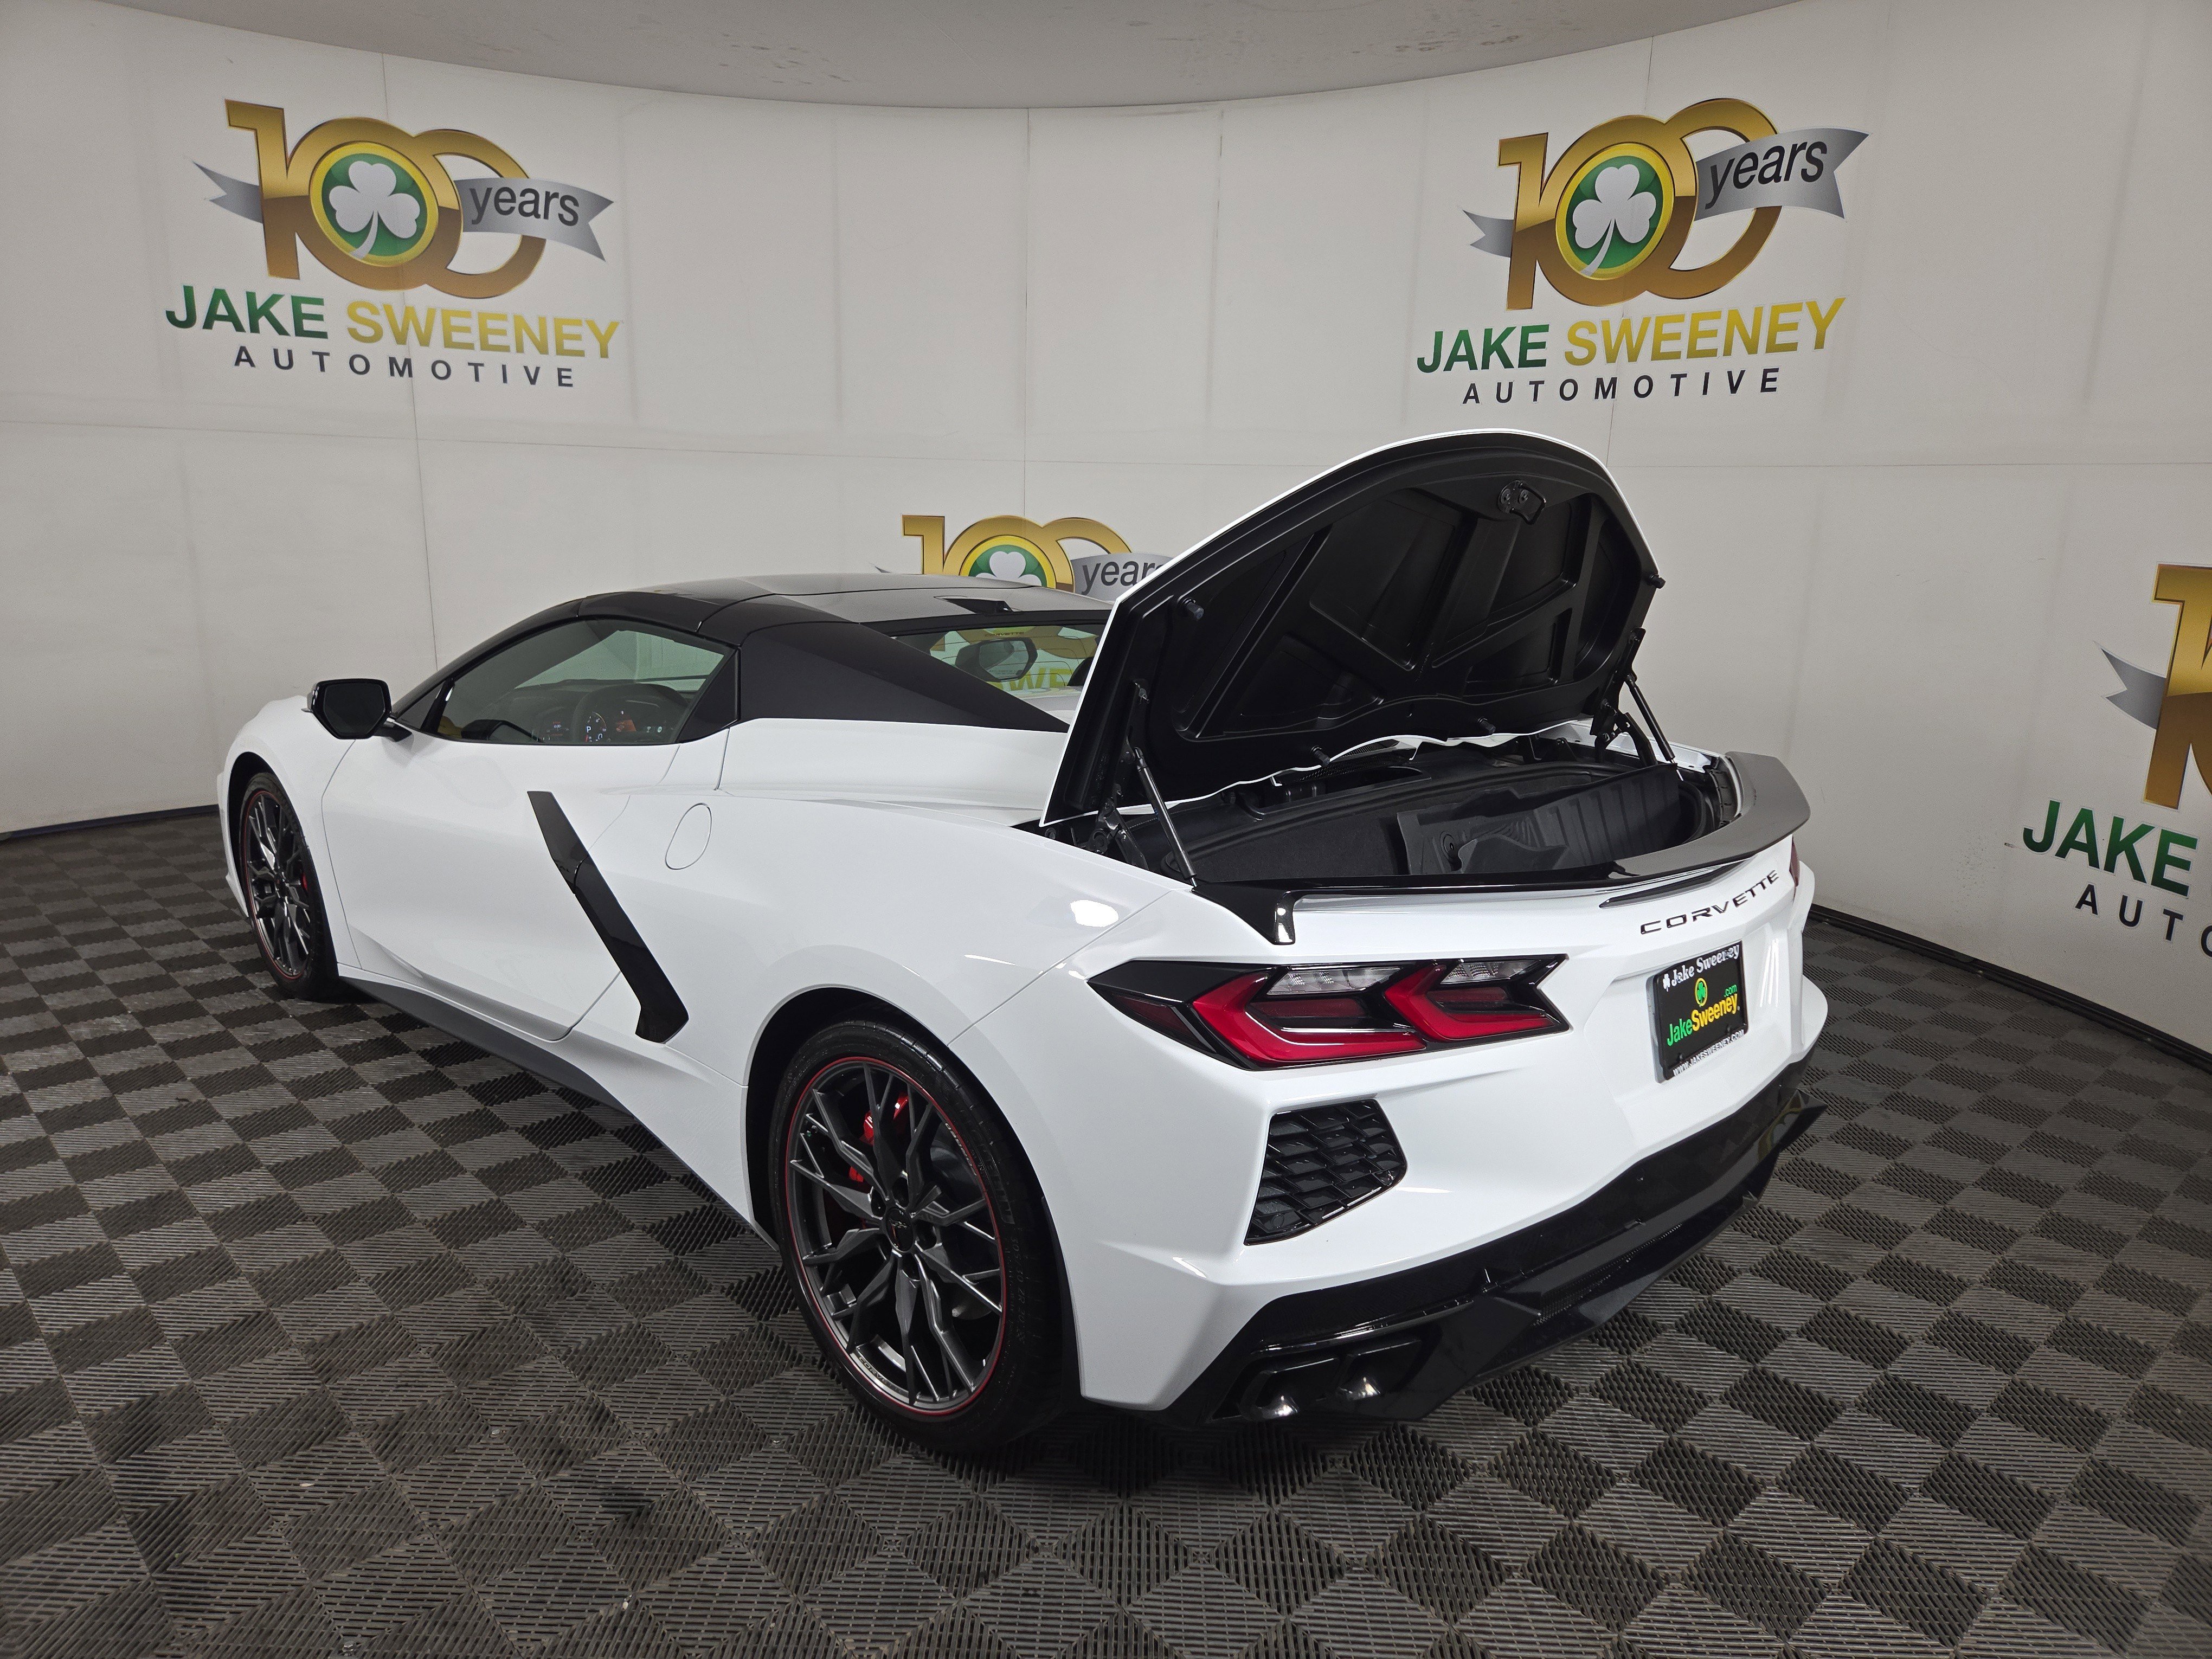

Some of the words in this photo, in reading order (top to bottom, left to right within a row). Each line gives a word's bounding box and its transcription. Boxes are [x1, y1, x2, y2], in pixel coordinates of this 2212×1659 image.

[1706, 141, 1828, 210] years
[470, 187, 580, 226] years
[166, 285, 329, 339] JAKE
[346, 300, 620, 358] SWEENEY
[1417, 325, 1549, 373] JAKE
[1565, 298, 1846, 366] SWEENEY
[234, 346, 574, 387] AUTOMOTIVE
[1463, 368, 1779, 404] AUTOMOTIVE
[1081, 561, 1164, 595] year
[2023, 800, 2198, 897] JAKE
[1641, 869, 1779, 935] CORVETTE
[1671, 964, 1695, 986] Jake
